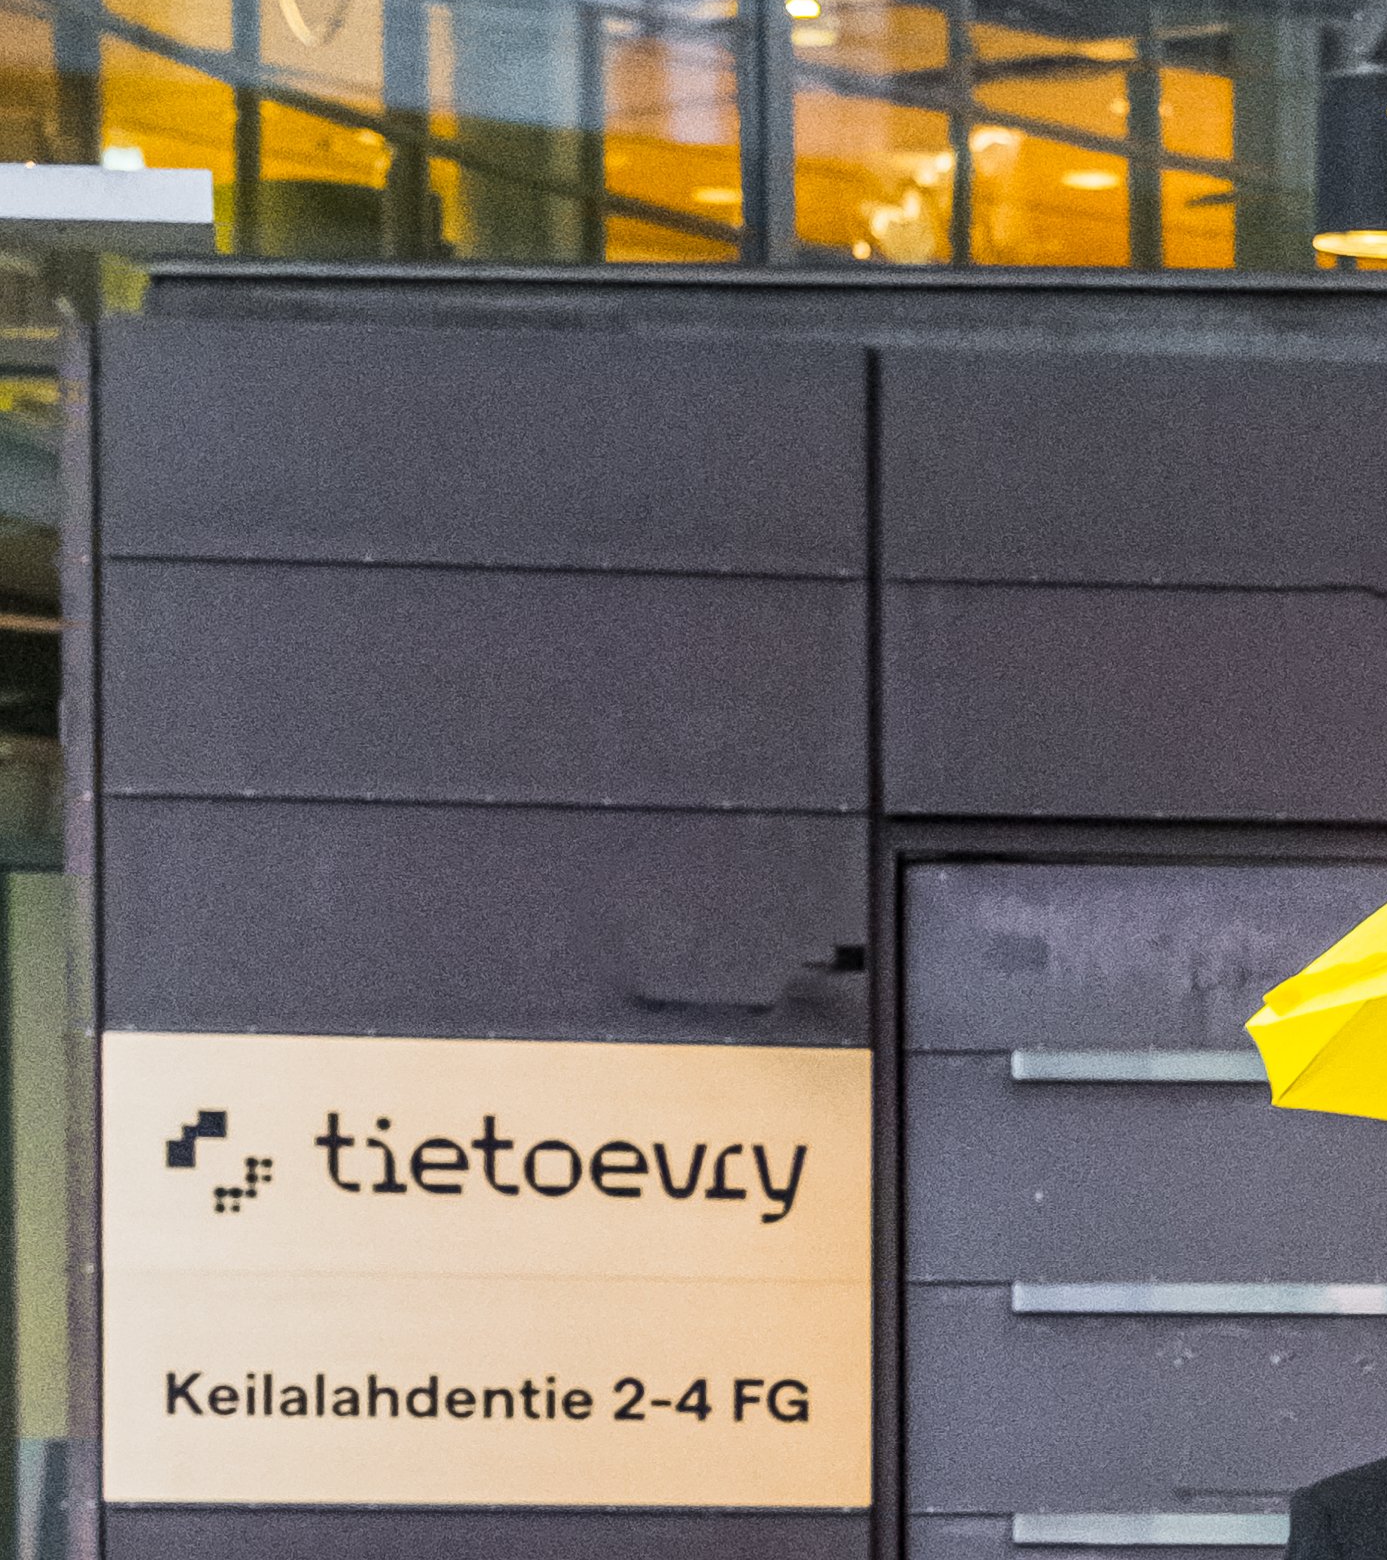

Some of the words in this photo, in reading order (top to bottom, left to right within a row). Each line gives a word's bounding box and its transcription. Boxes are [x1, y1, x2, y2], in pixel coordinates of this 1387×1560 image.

[314, 1111, 809, 1225] tietoevry
[165, 1371, 595, 1422] Keilalahdentie
[612, 1375, 714, 1423] 2-4
[732, 1377, 811, 1425] FG
